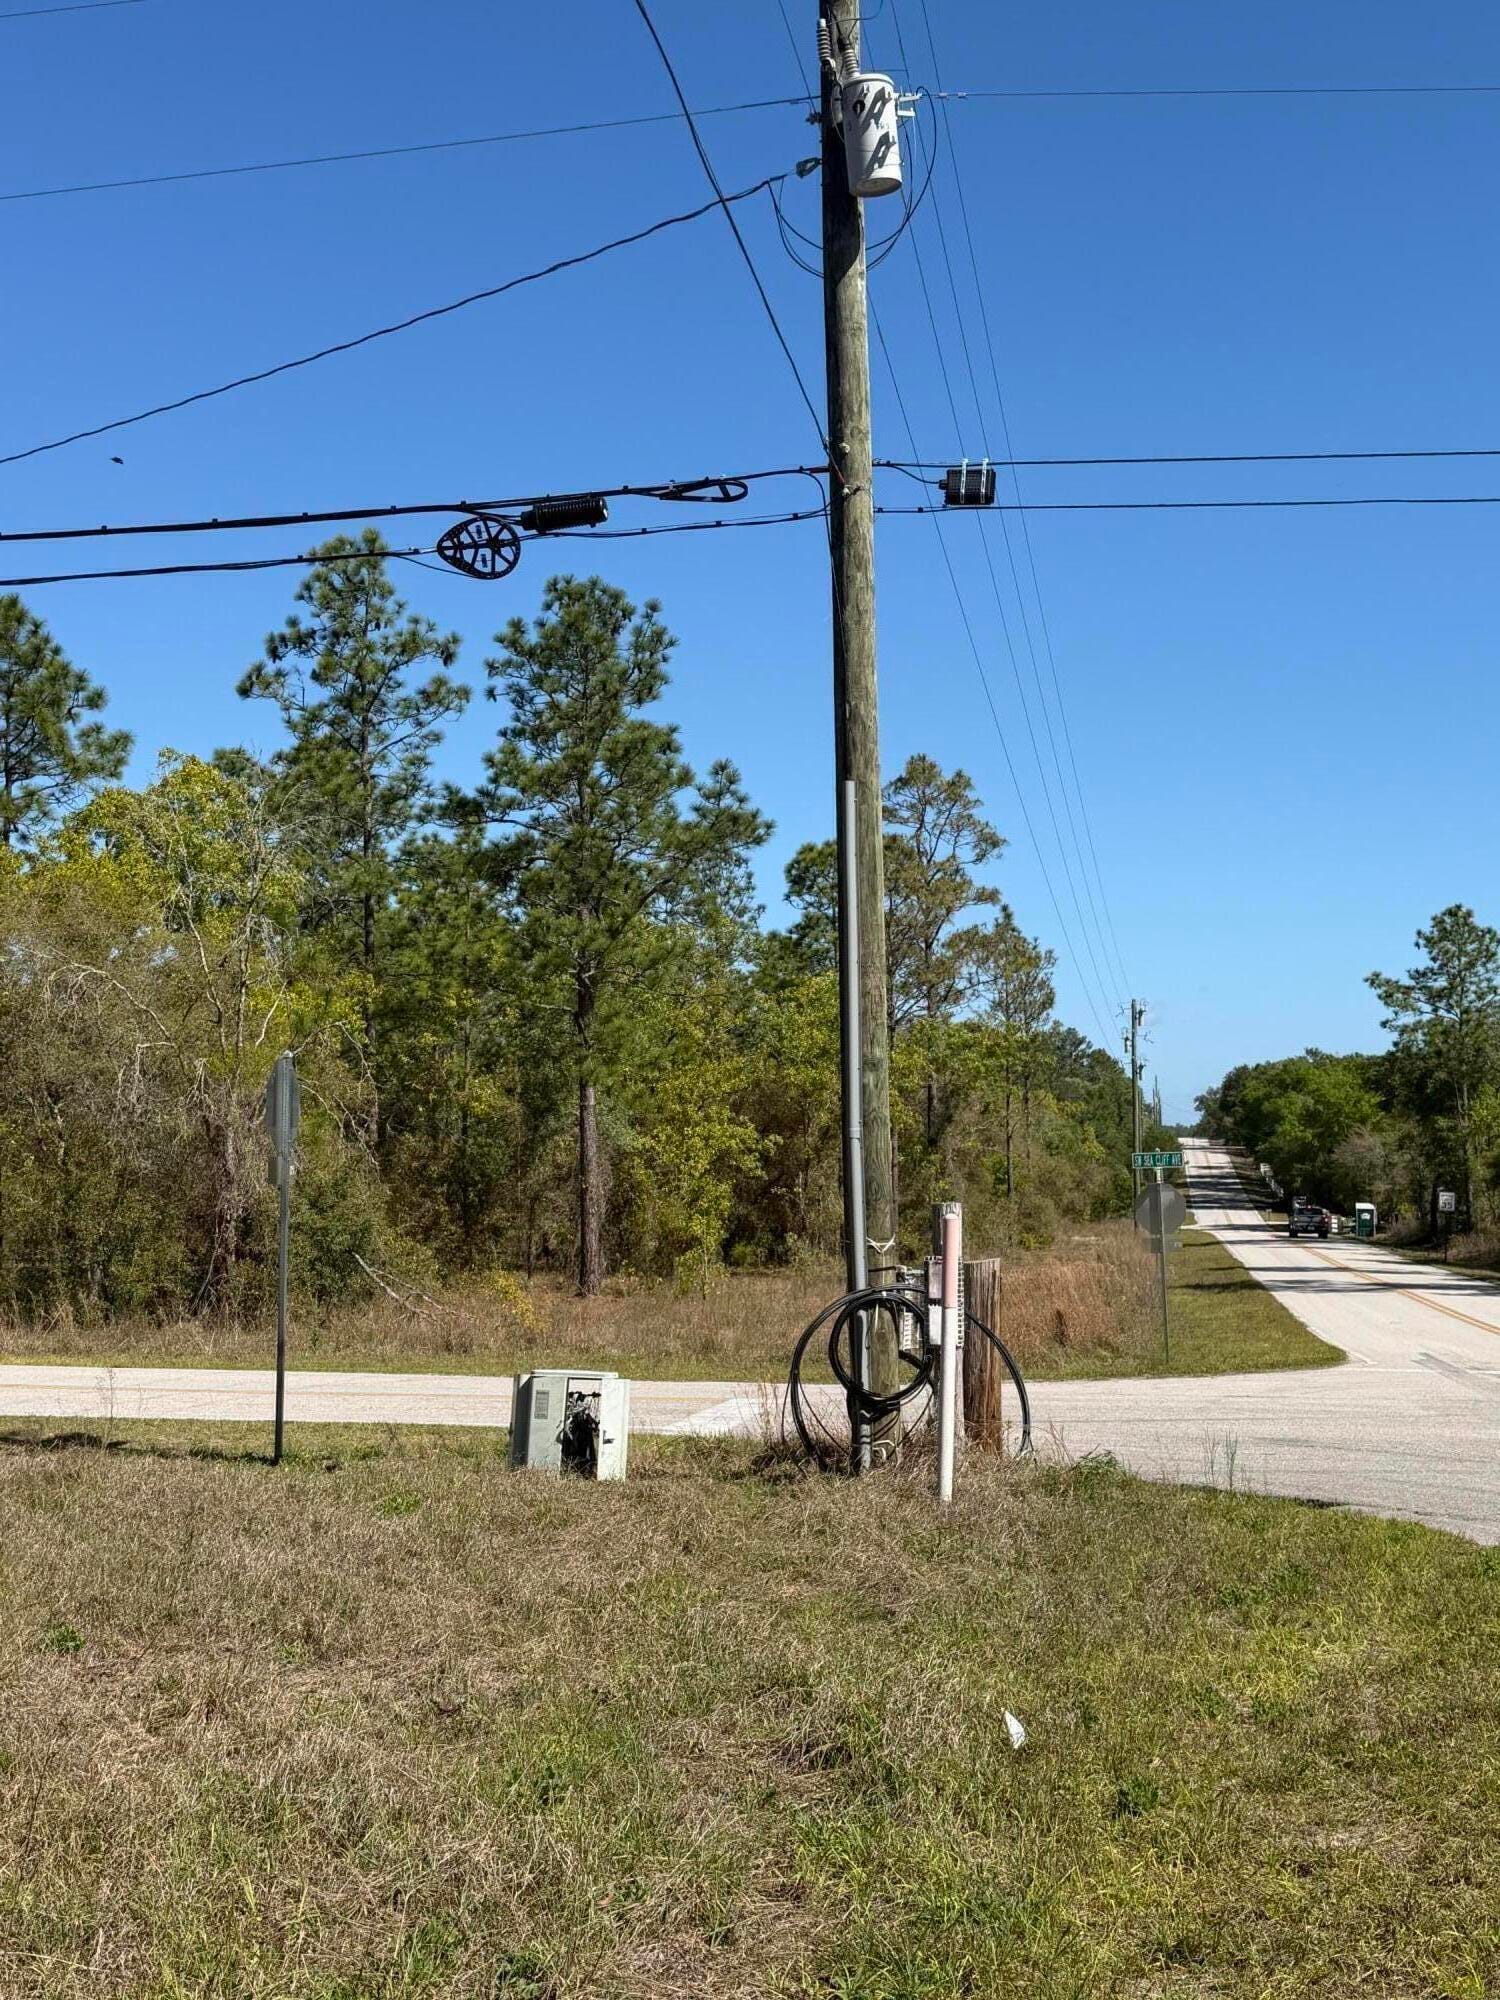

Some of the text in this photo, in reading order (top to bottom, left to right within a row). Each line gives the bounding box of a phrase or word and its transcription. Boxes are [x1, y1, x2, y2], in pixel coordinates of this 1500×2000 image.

[1144, 1155, 1154, 1166] SEA
[1156, 1154, 1170, 1166] CLIFF
[1172, 1154, 1181, 1165] AVE
